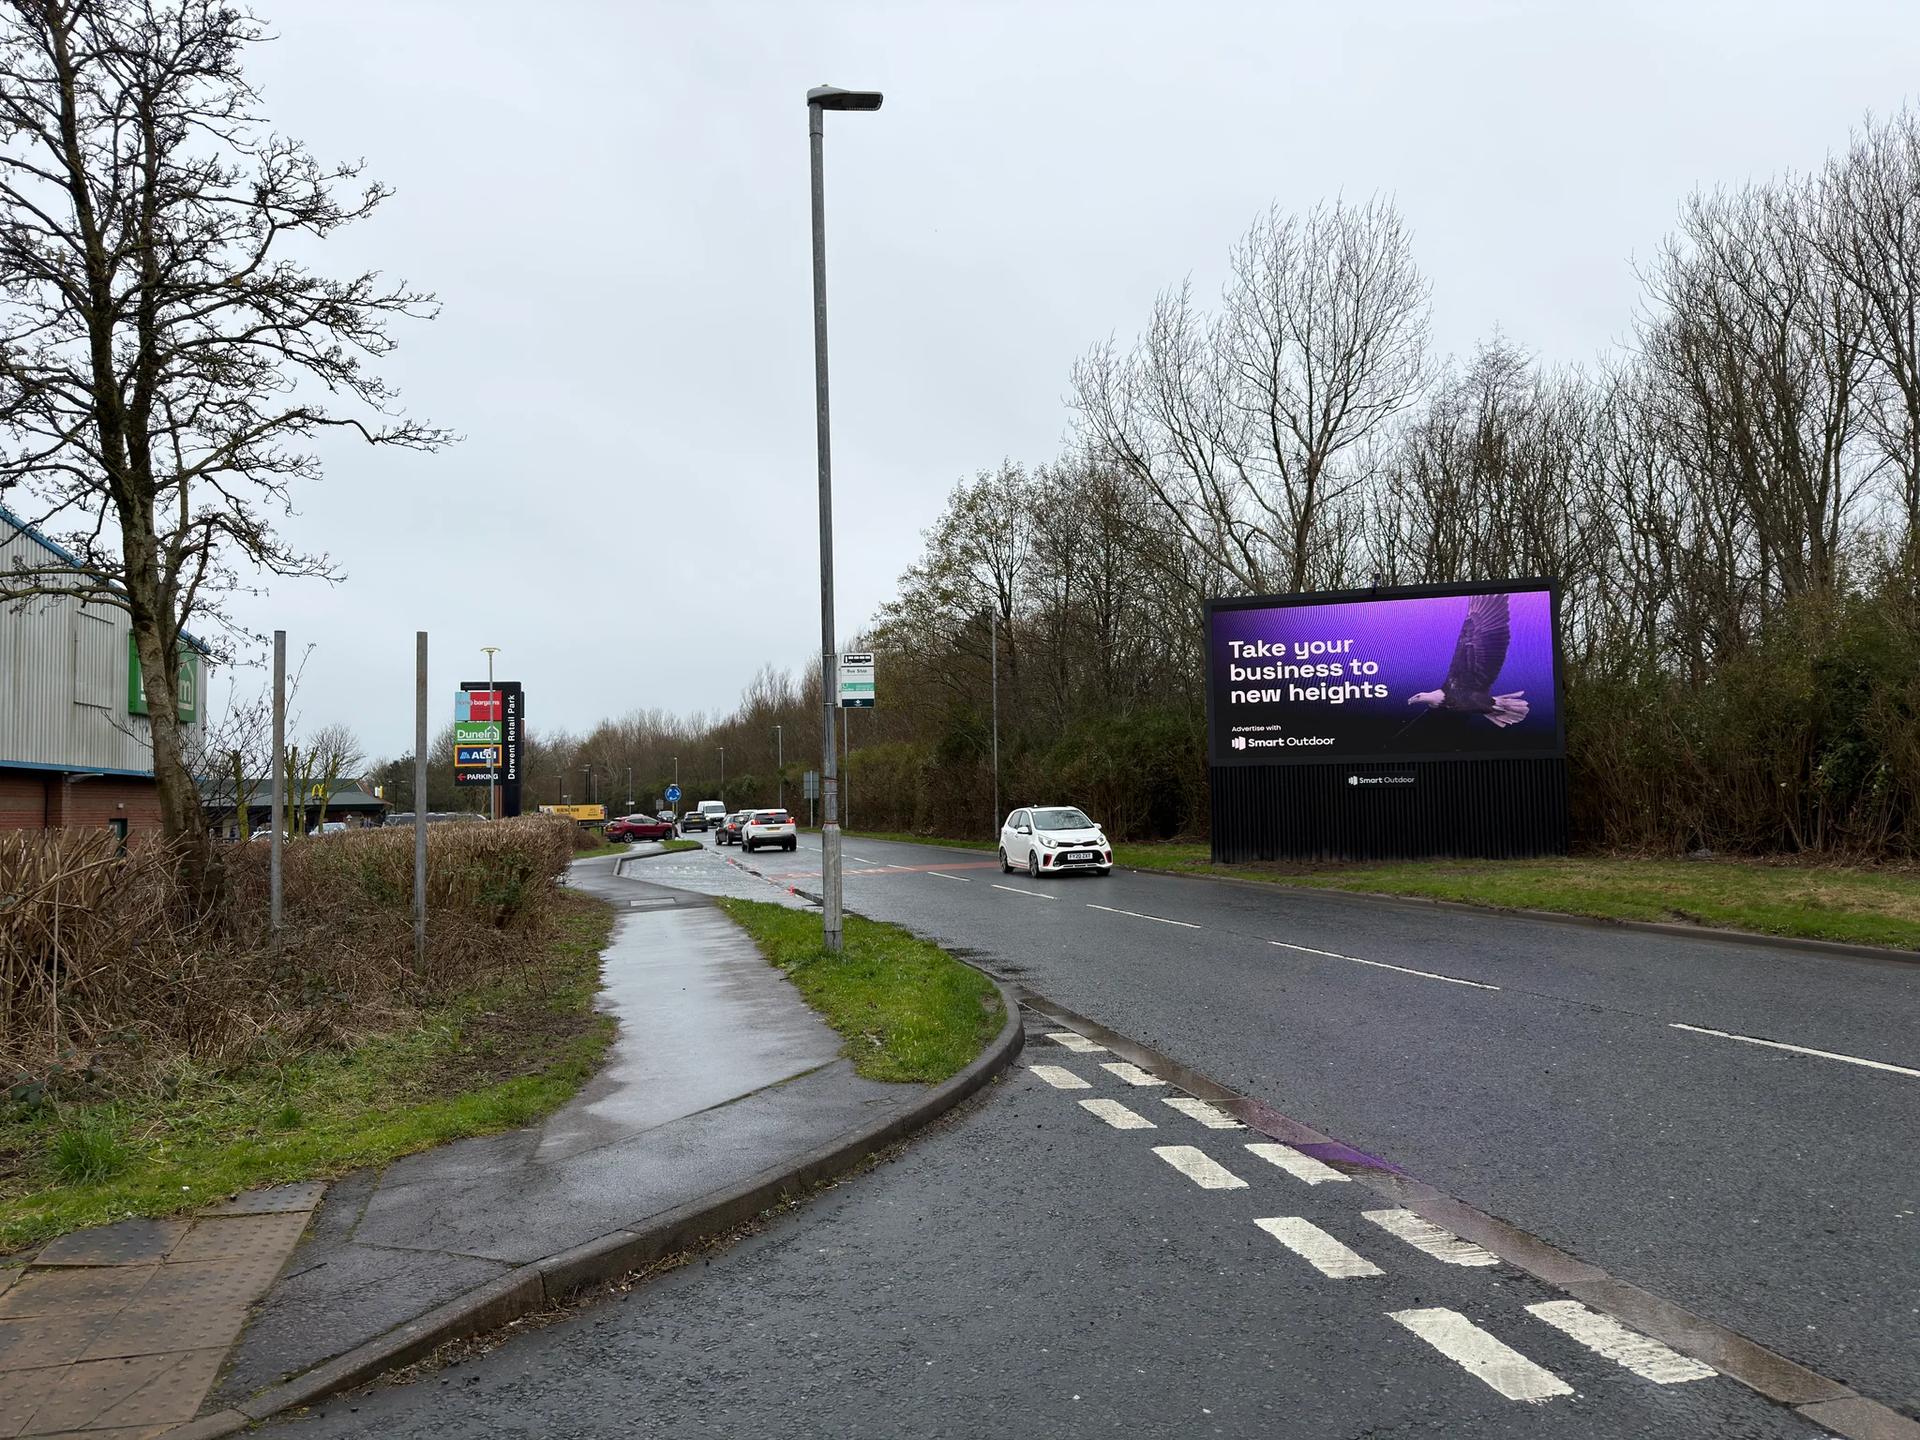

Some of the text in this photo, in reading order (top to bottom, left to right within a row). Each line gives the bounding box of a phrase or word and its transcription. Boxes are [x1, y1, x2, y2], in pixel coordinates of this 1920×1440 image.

[1229, 639, 1354, 660] Take your
[1230, 658, 1379, 681] business to
[1231, 681, 1388, 704] new heights
[507, 694, 516, 780] Derwent Retail Park
[1231, 724, 1282, 733] Advertise with
[1248, 736, 1335, 748] Smart Outdoor
[1359, 775, 1415, 784] Smart Outdoor
